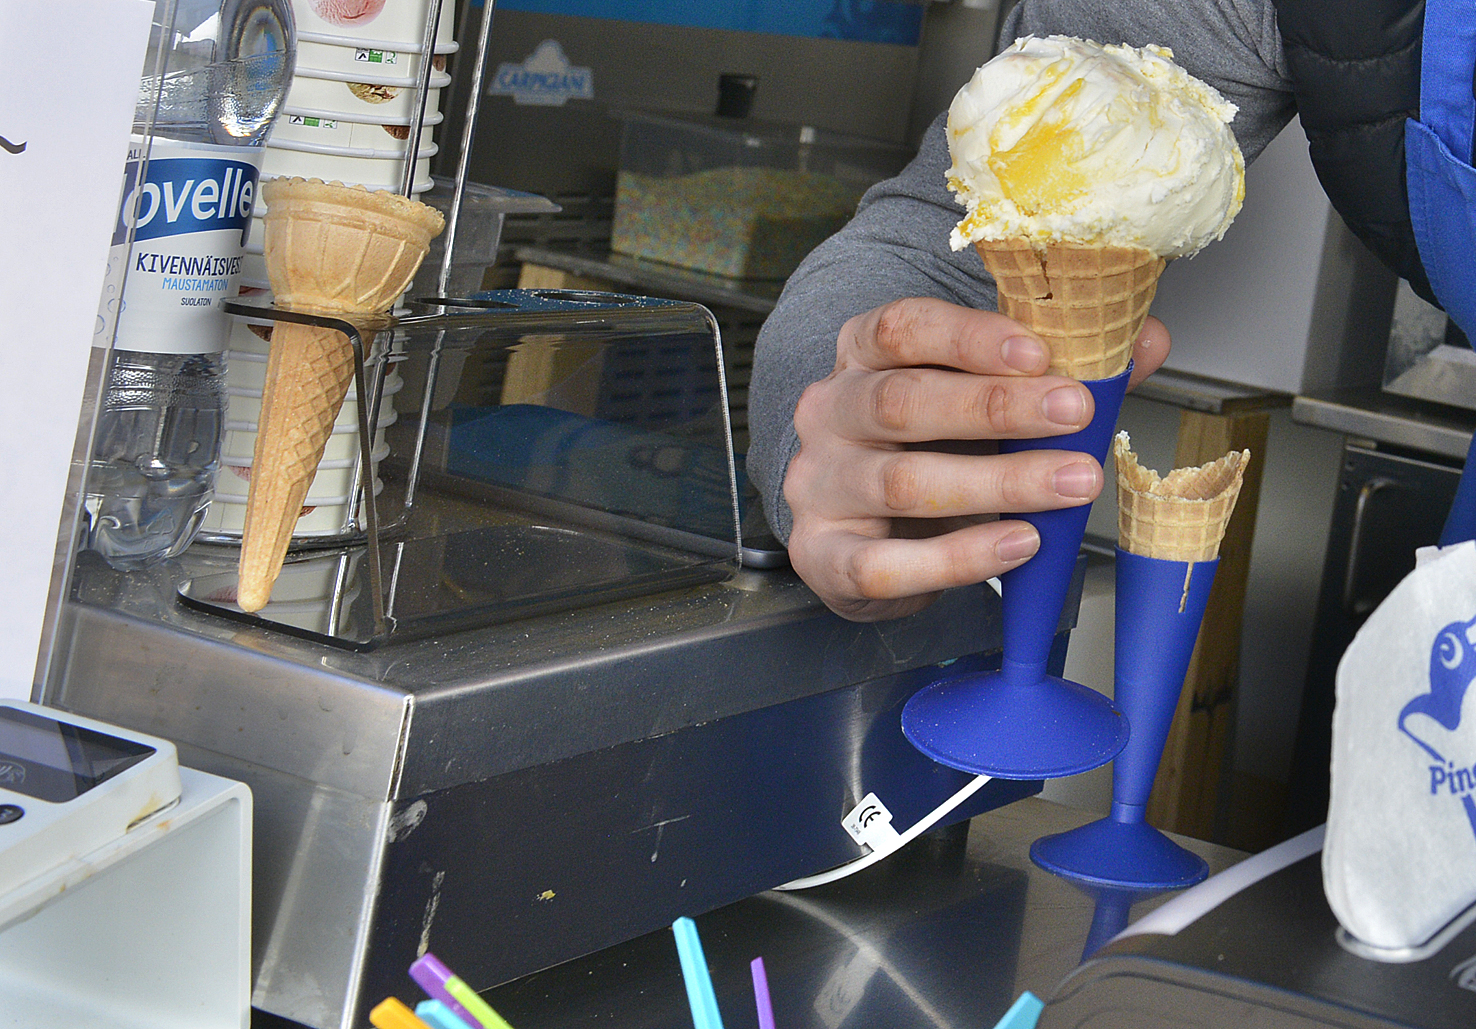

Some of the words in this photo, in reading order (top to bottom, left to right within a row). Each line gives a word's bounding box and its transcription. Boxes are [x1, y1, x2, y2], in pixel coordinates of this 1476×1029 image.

[121, 167, 253, 230] ovelle
[162, 278, 228, 291] MAUSTAMATON
[181, 297, 212, 307] SUOLATON
